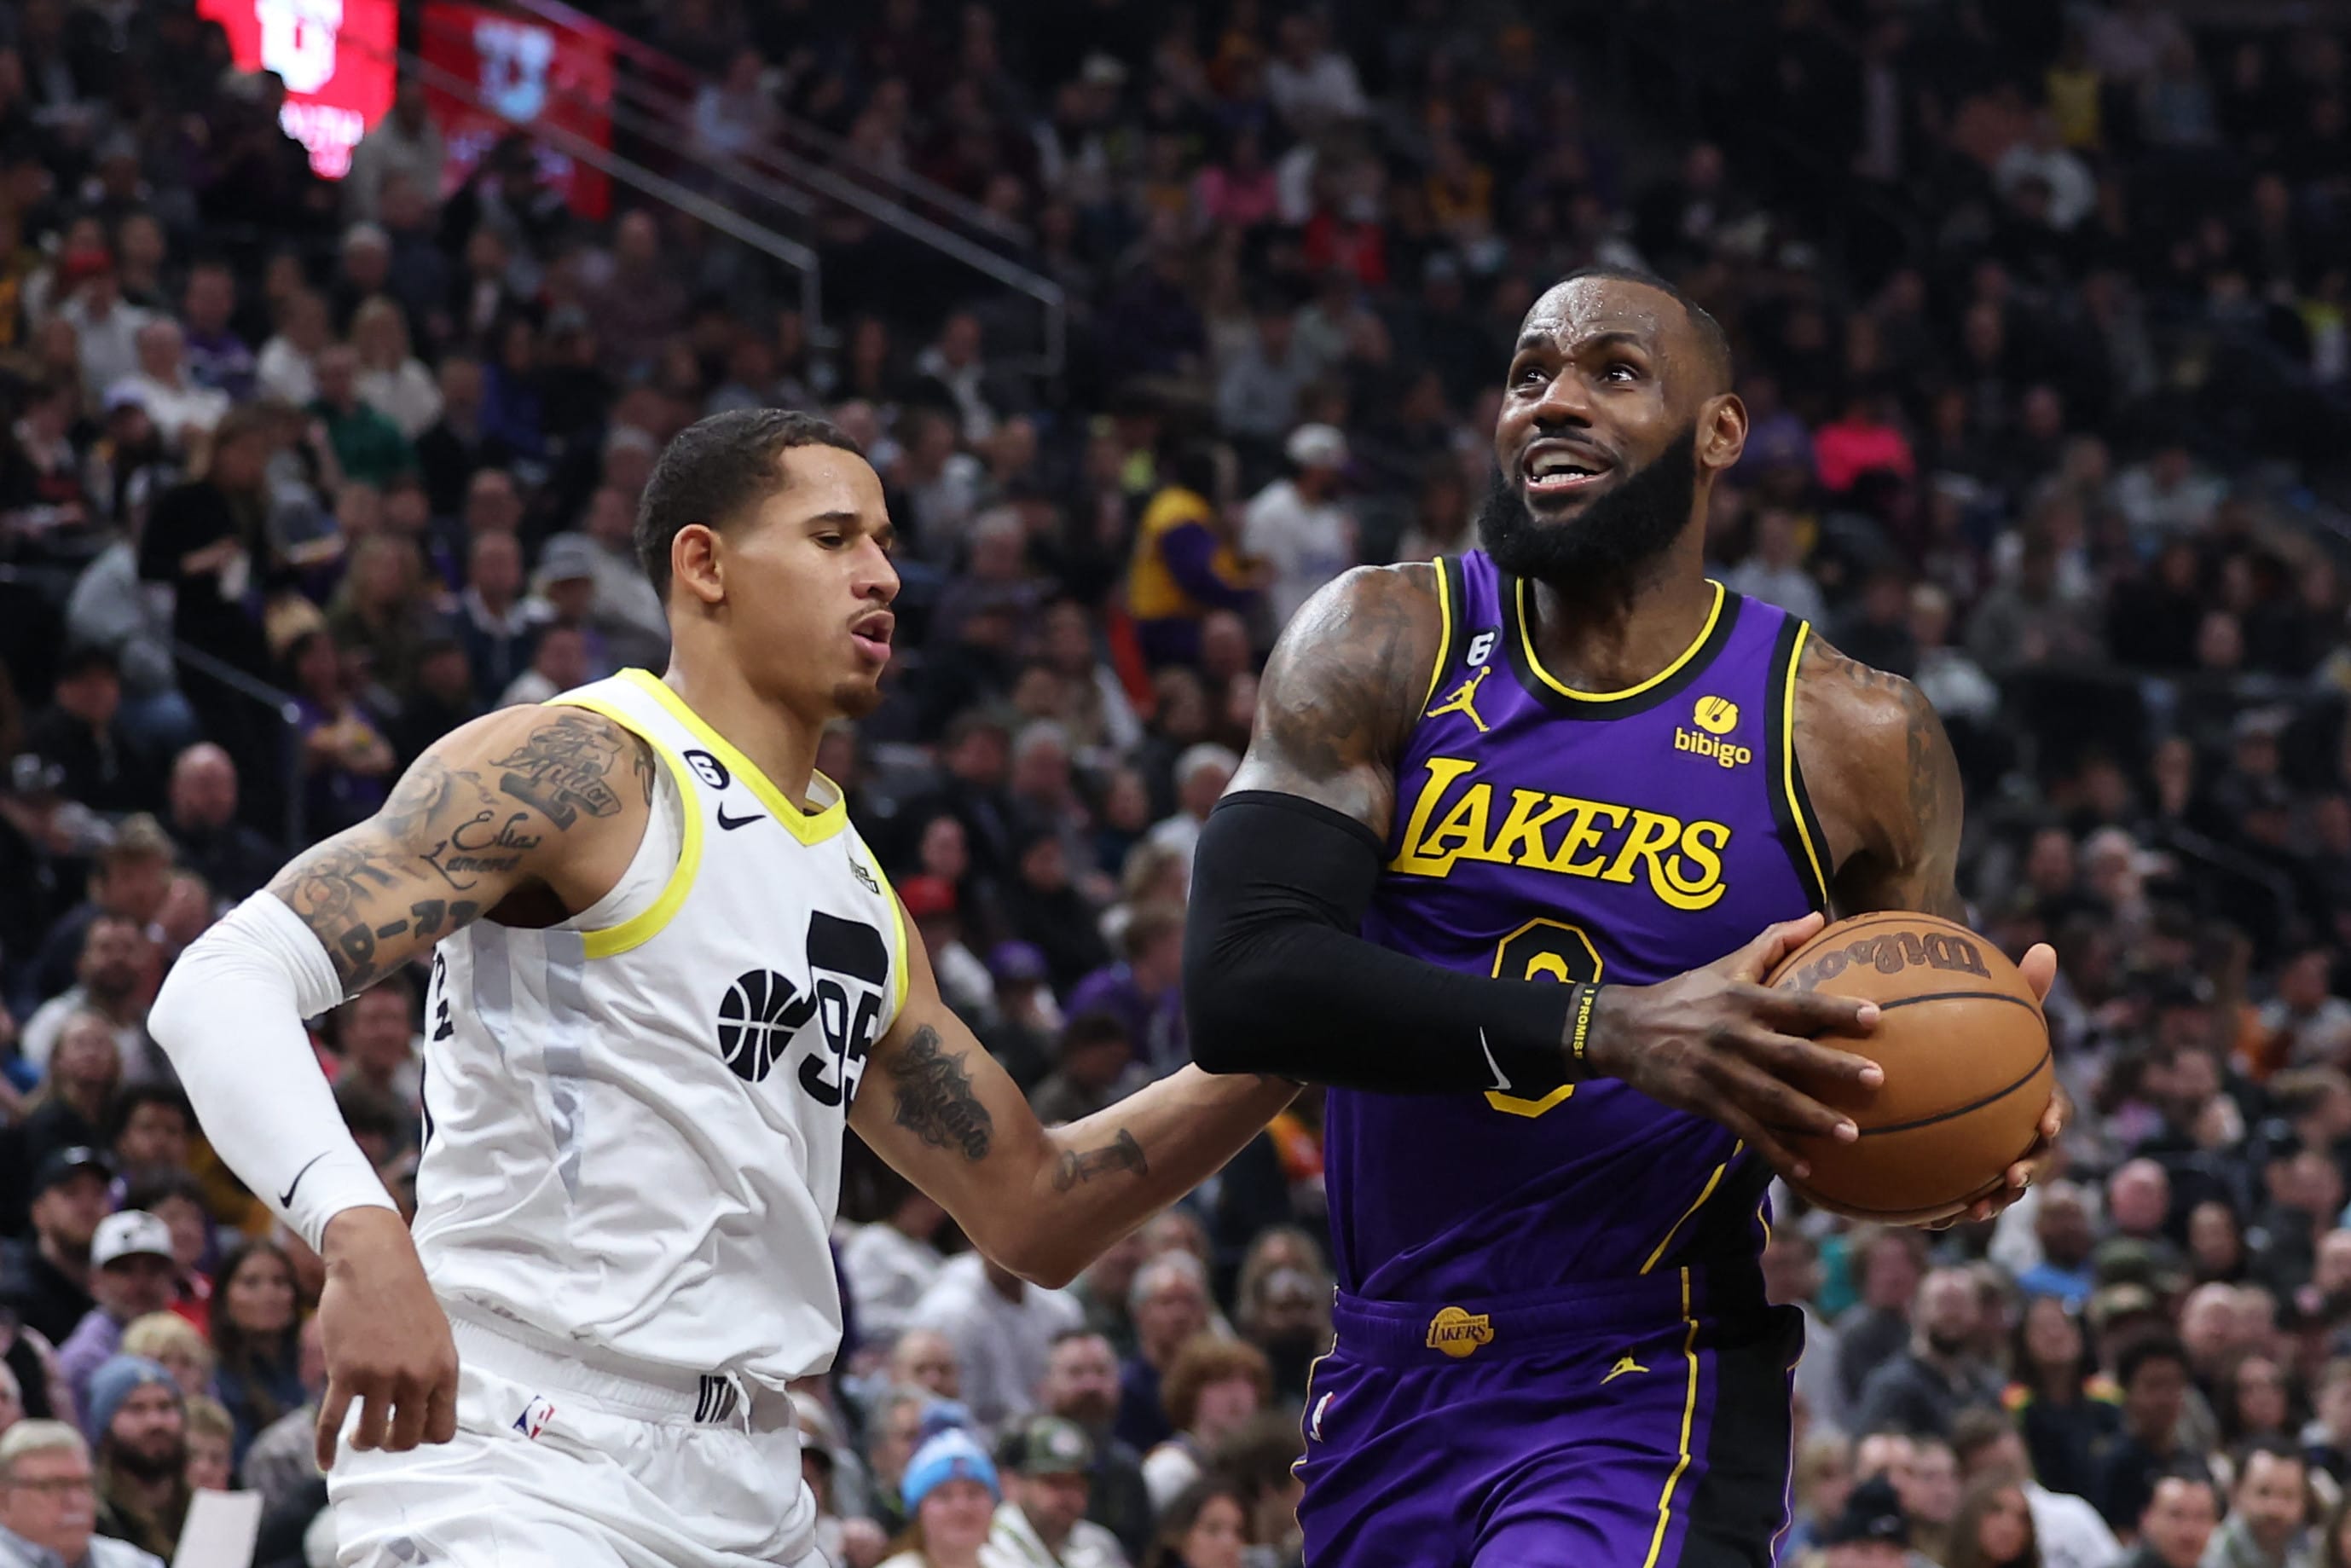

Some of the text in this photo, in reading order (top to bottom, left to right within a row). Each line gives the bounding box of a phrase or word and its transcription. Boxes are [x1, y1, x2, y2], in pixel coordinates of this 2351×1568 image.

[1467, 631, 1495, 667] 6
[1675, 727, 1752, 768] bibigo
[1387, 756, 1732, 911] LAKERS
